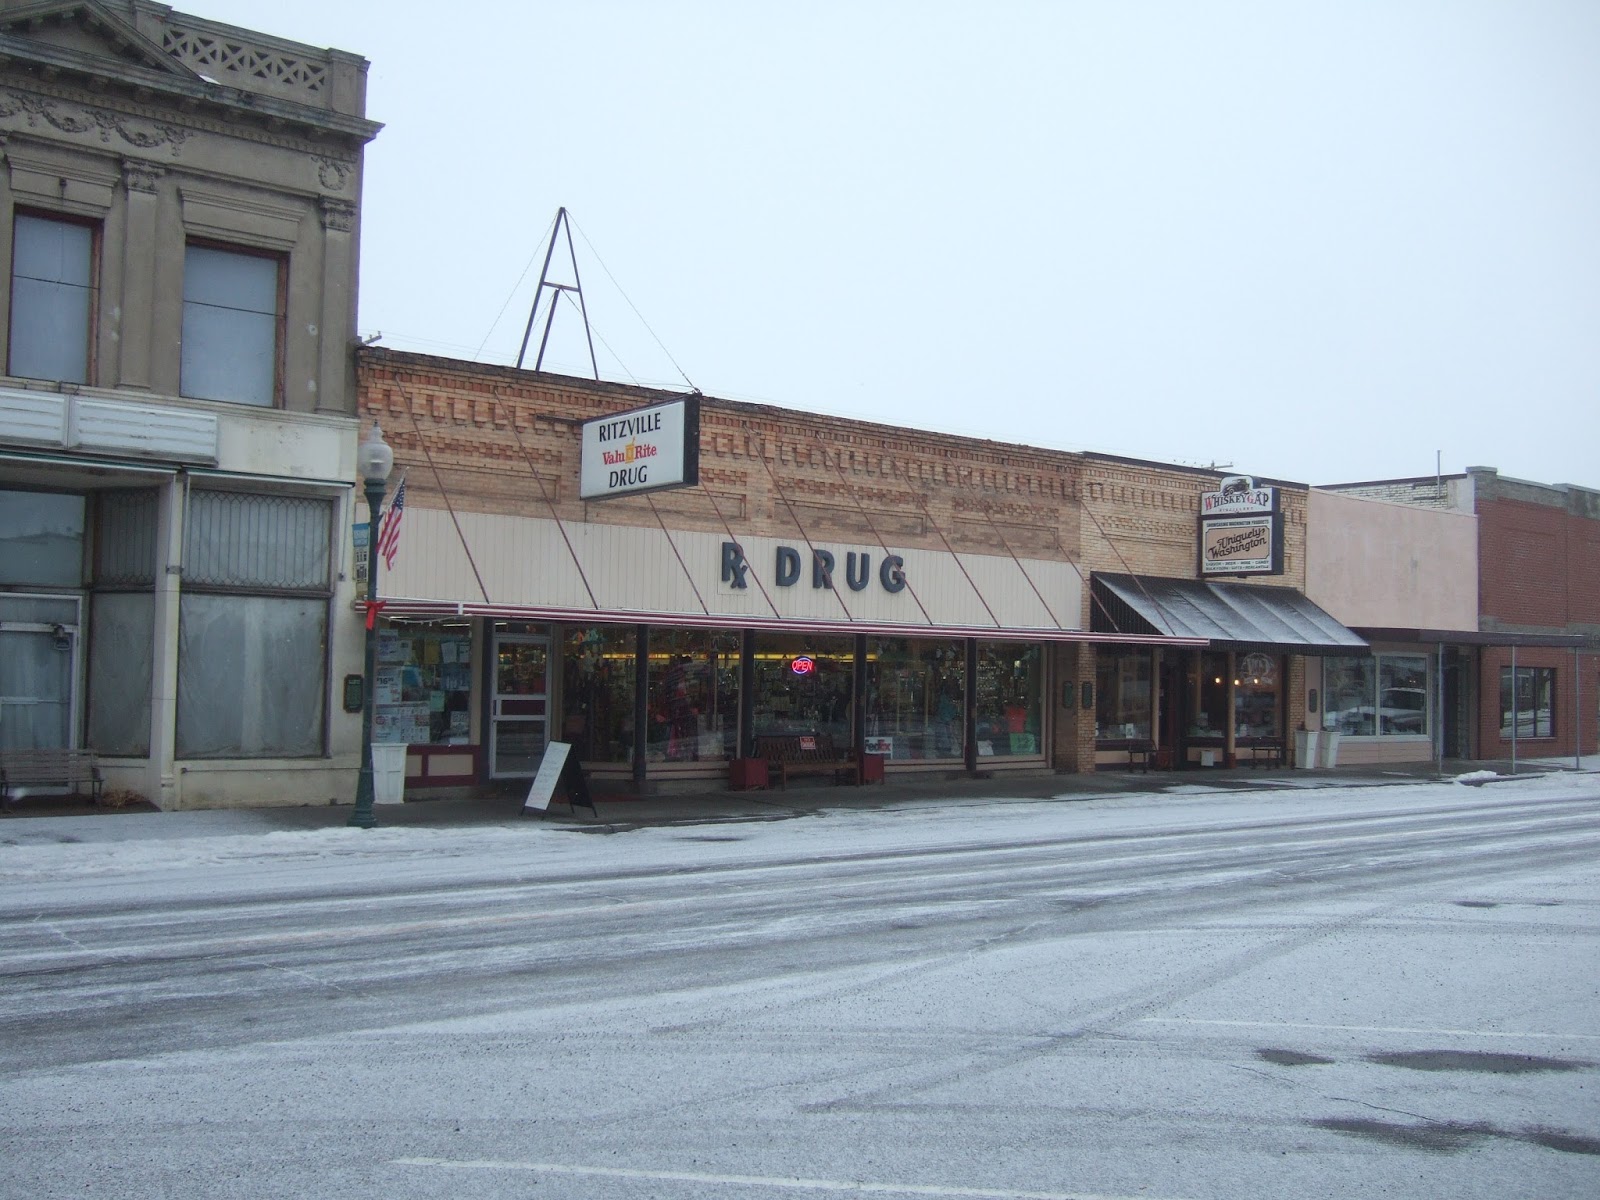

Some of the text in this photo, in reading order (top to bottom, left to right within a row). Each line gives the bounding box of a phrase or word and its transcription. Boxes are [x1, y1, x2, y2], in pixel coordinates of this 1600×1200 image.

[599, 412, 661, 442] RITZVILLE
[602, 444, 657, 465] Valu Rite
[608, 465, 648, 488] DRUG
[1205, 490, 1270, 511] WHISKEY GAP
[1208, 537, 1267, 560] Washington
[1217, 528, 1266, 549] Uniquely
[775, 545, 906, 593] DRUG
[791, 659, 813, 672] OPEN
[864, 739, 892, 752] FedEx
